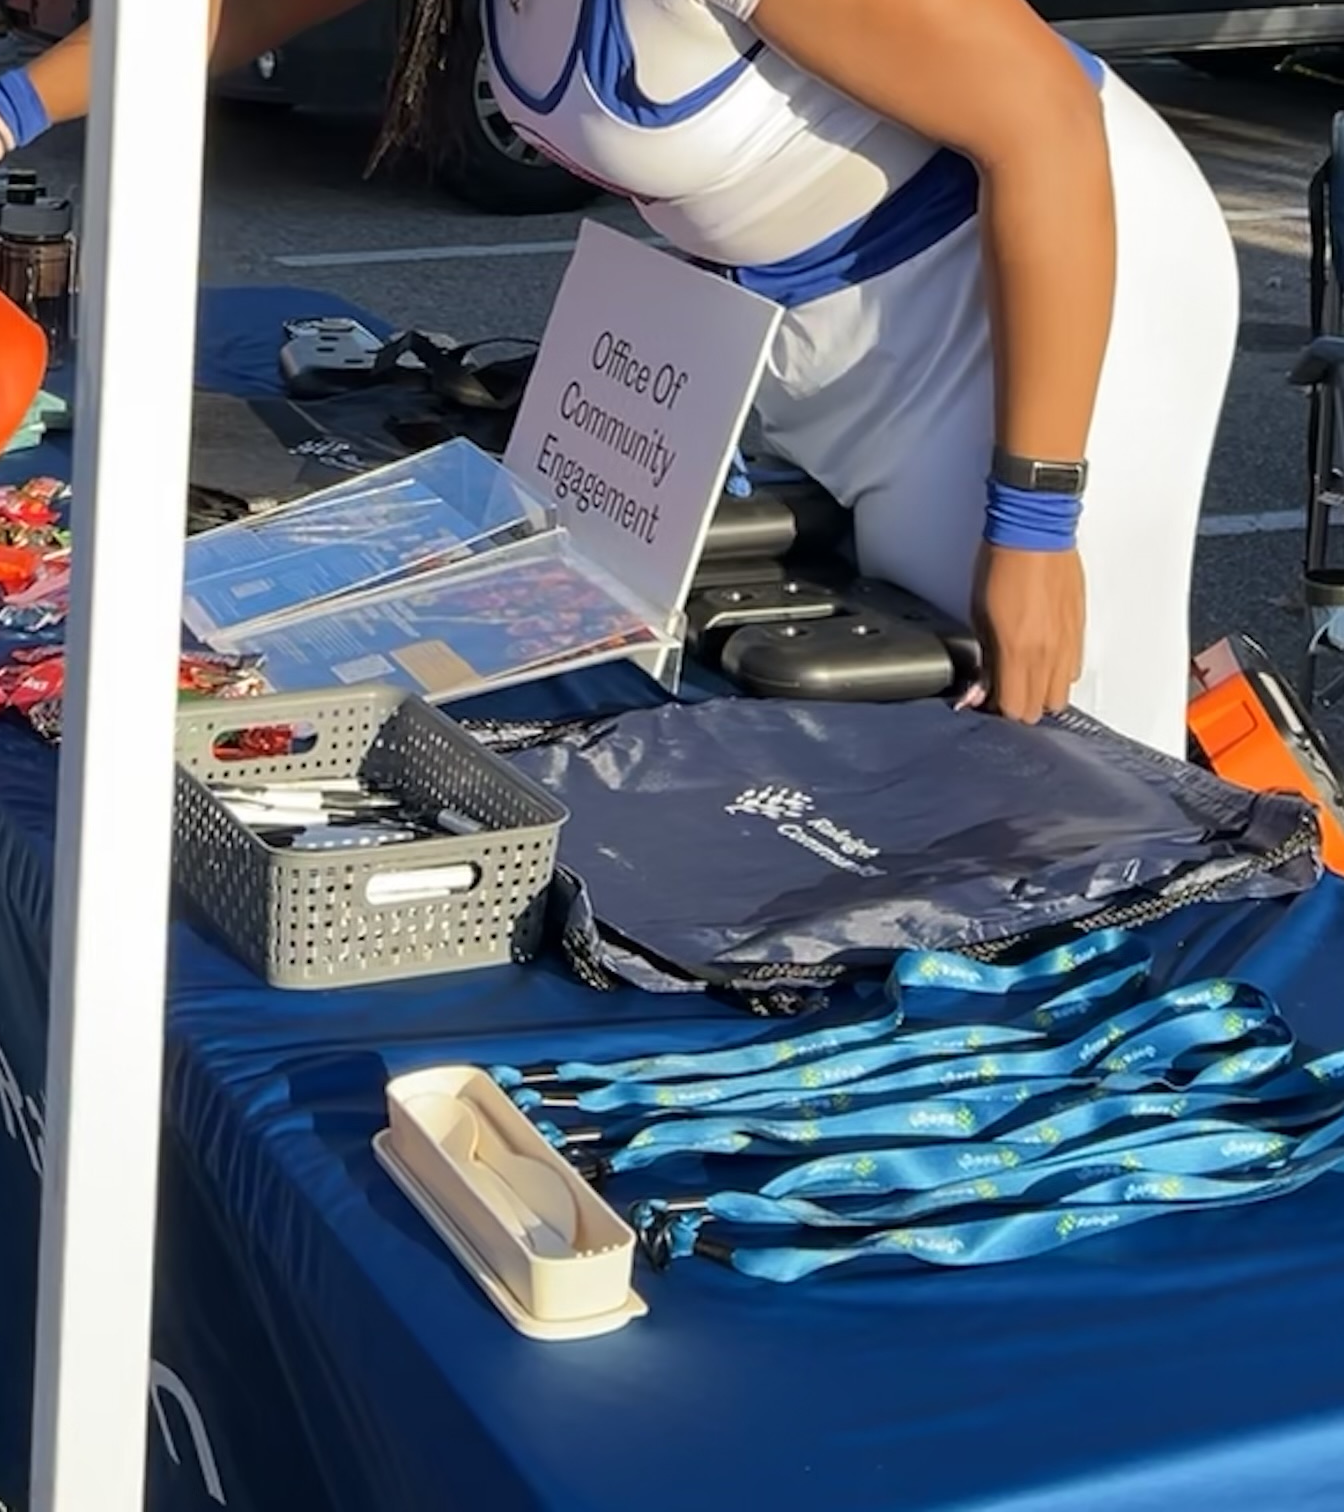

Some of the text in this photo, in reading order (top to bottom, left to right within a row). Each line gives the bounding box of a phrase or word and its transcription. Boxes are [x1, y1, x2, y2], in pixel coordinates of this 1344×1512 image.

[592, 331, 689, 410] Office Of
[560, 381, 677, 488] Community
[537, 434, 660, 545] Engagement
